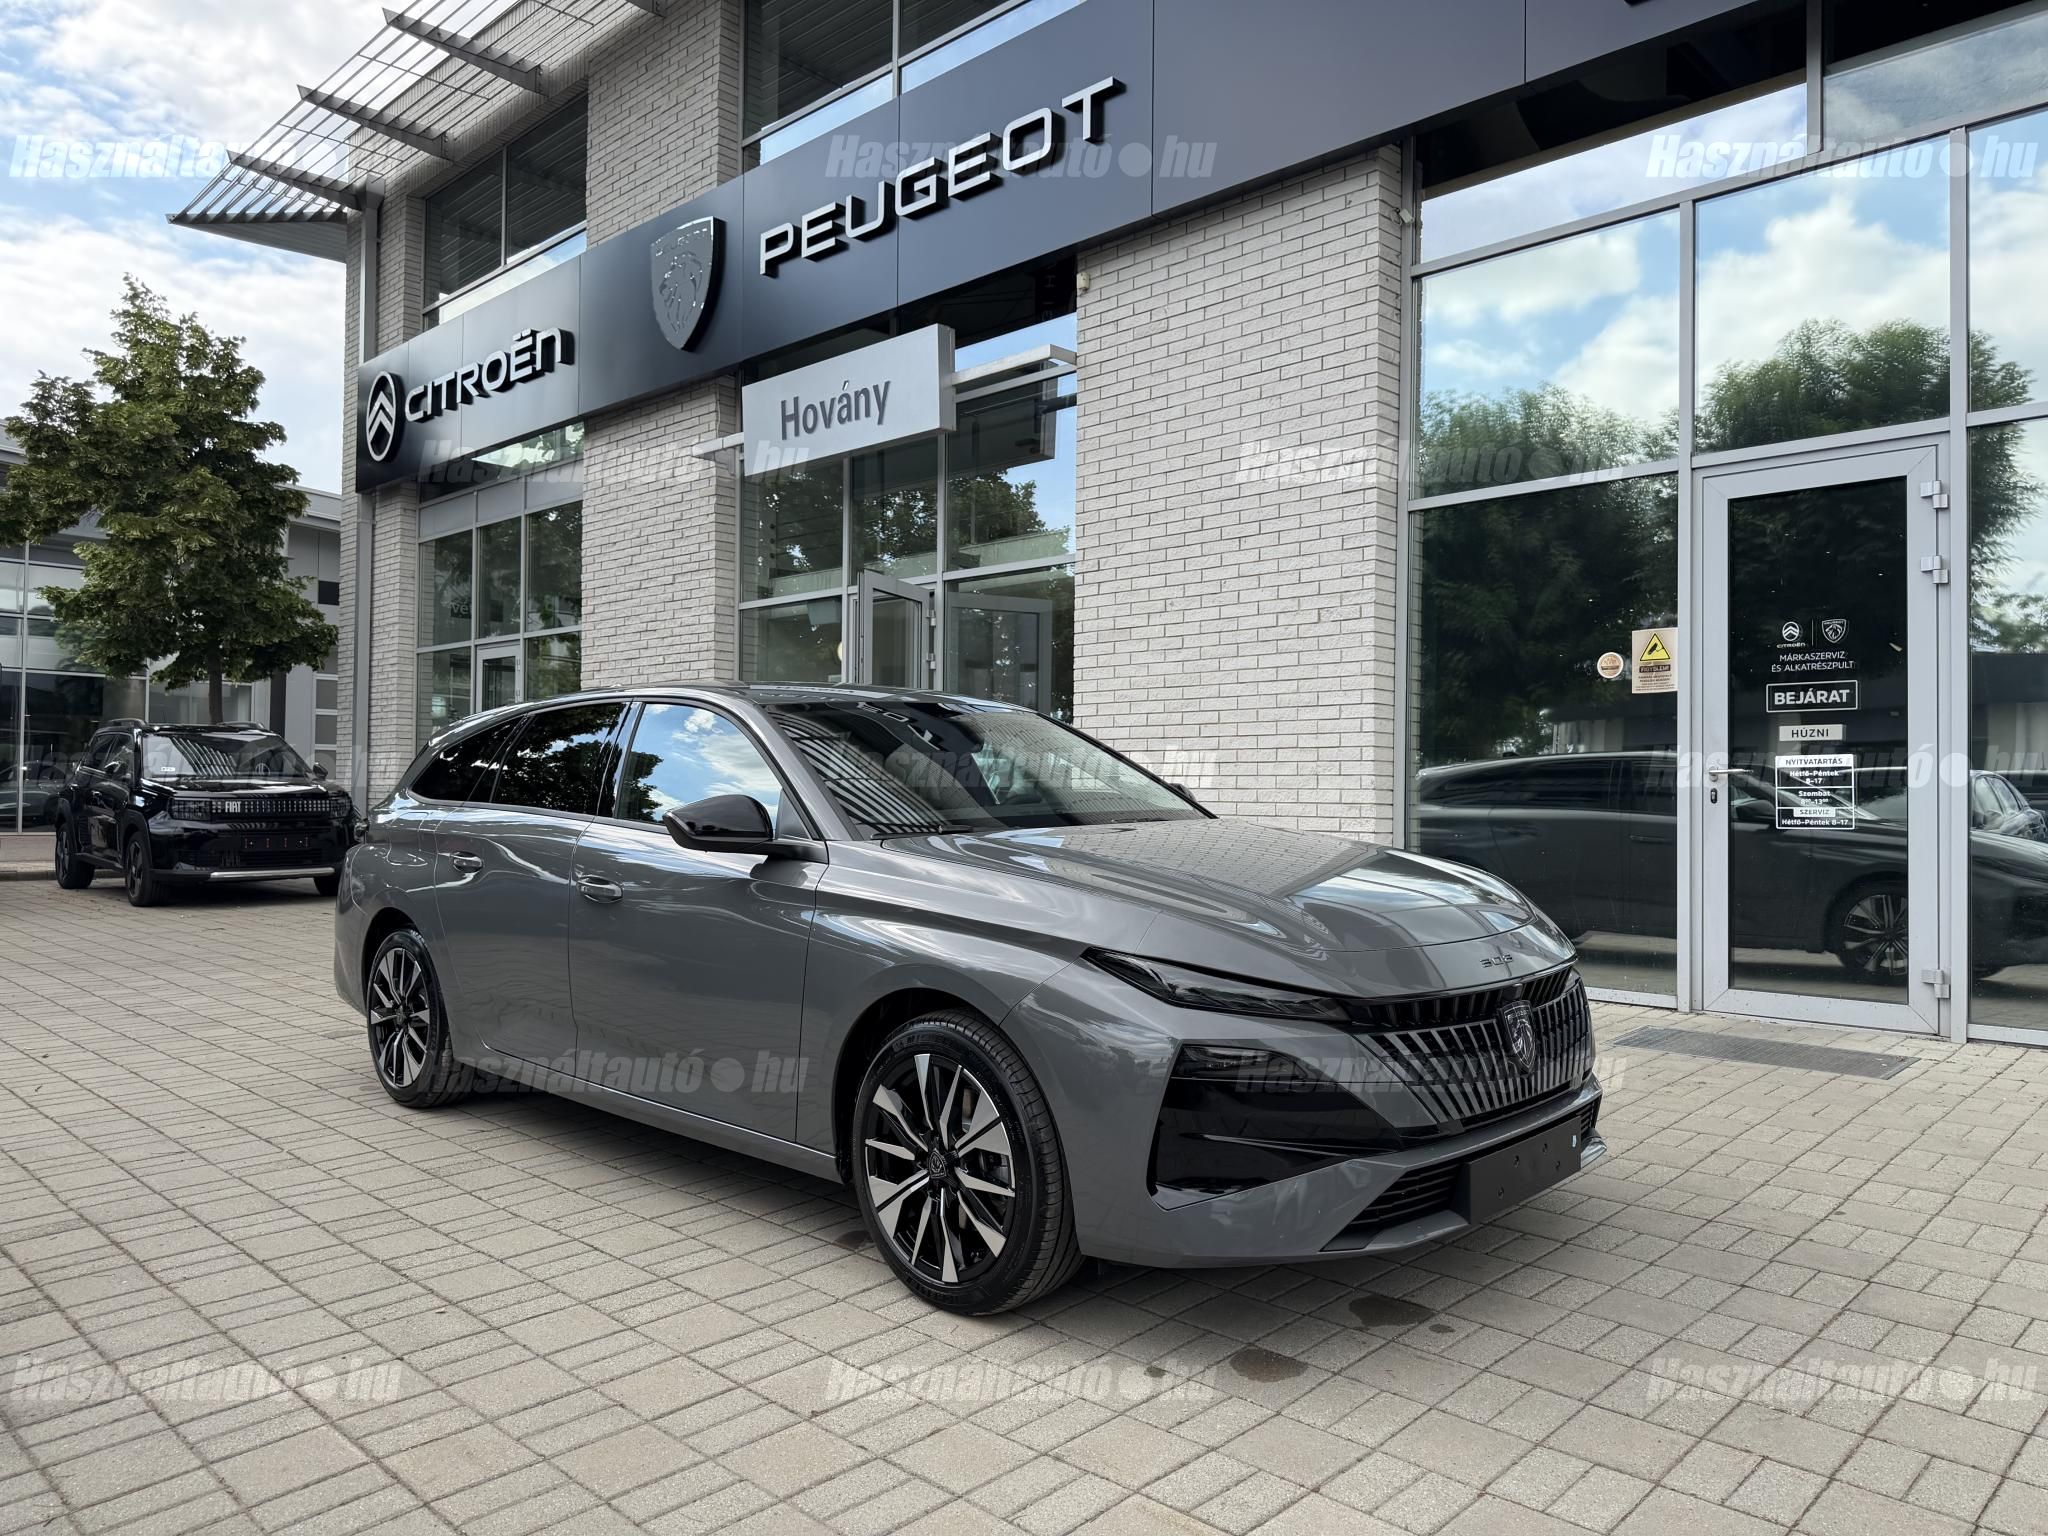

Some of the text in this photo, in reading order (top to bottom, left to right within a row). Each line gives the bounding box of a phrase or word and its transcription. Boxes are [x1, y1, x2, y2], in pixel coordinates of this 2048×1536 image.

[760, 76, 1116, 276] PEUGEOT
[780, 379, 891, 440] Hovány
[1779, 651, 1846, 662] MÁRKASZERVIZ
[1771, 660, 1855, 673] ÉS ALKATRÉSZPULT
[1774, 688, 1850, 705] BEJÁRAT
[1791, 727, 1829, 738] HÚZNI
[1785, 757, 1843, 765] NYITVATARTÁS
[225, 801, 241, 813] FIAT
